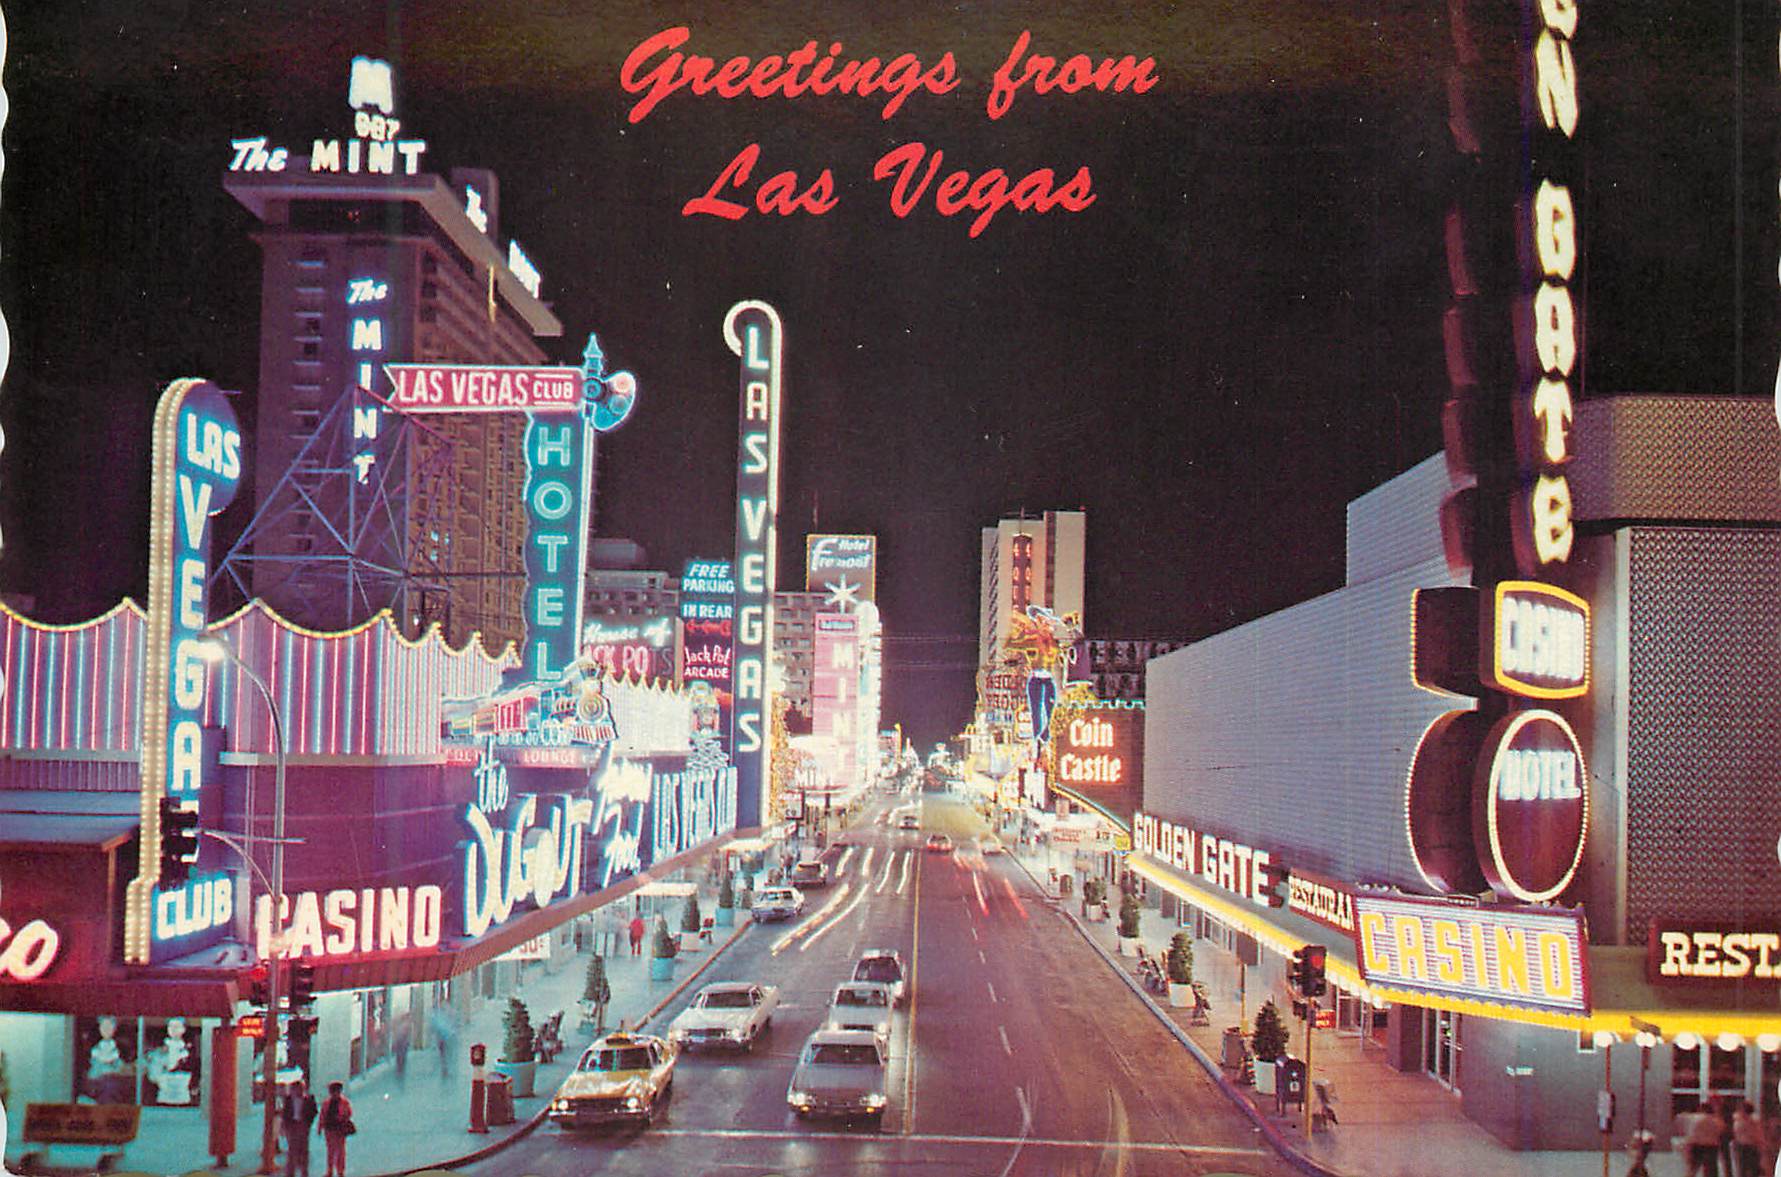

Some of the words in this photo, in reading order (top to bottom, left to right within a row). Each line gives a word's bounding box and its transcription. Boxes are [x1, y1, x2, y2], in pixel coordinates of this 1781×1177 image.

[348, 55, 394, 115] M
[230, 137, 288, 172] The
[311, 139, 426, 175] MINT
[347, 279, 388, 304] The
[400, 370, 444, 402] LAS
[451, 372, 529, 406] VEGAS
[533, 382, 574, 400] CLUB
[1534, 179, 1576, 564] GATE
[351, 319, 383, 485] MINT
[741, 326, 769, 475] LAS
[186, 412, 242, 481] LAS
[533, 427, 573, 681] HOTEL
[688, 563, 731, 578] FREE
[683, 578, 735, 593] PARKING
[683, 603, 697, 618] IN
[699, 604, 732, 618] REAR
[738, 499, 769, 753] VEGAS
[684, 643, 710, 666] Jack
[684, 666, 730, 679] ARCADE
[1069, 716, 1114, 748] Coin
[1059, 751, 1122, 783] Castle
[1134, 812, 1196, 874] GOLDEN
[1202, 834, 1270, 909] GATE
[156, 878, 233, 940] CLUB
[253, 884, 443, 961] CASINO
[1358, 912, 1573, 1000] CASINO
[1660, 931, 1781, 978] REST
